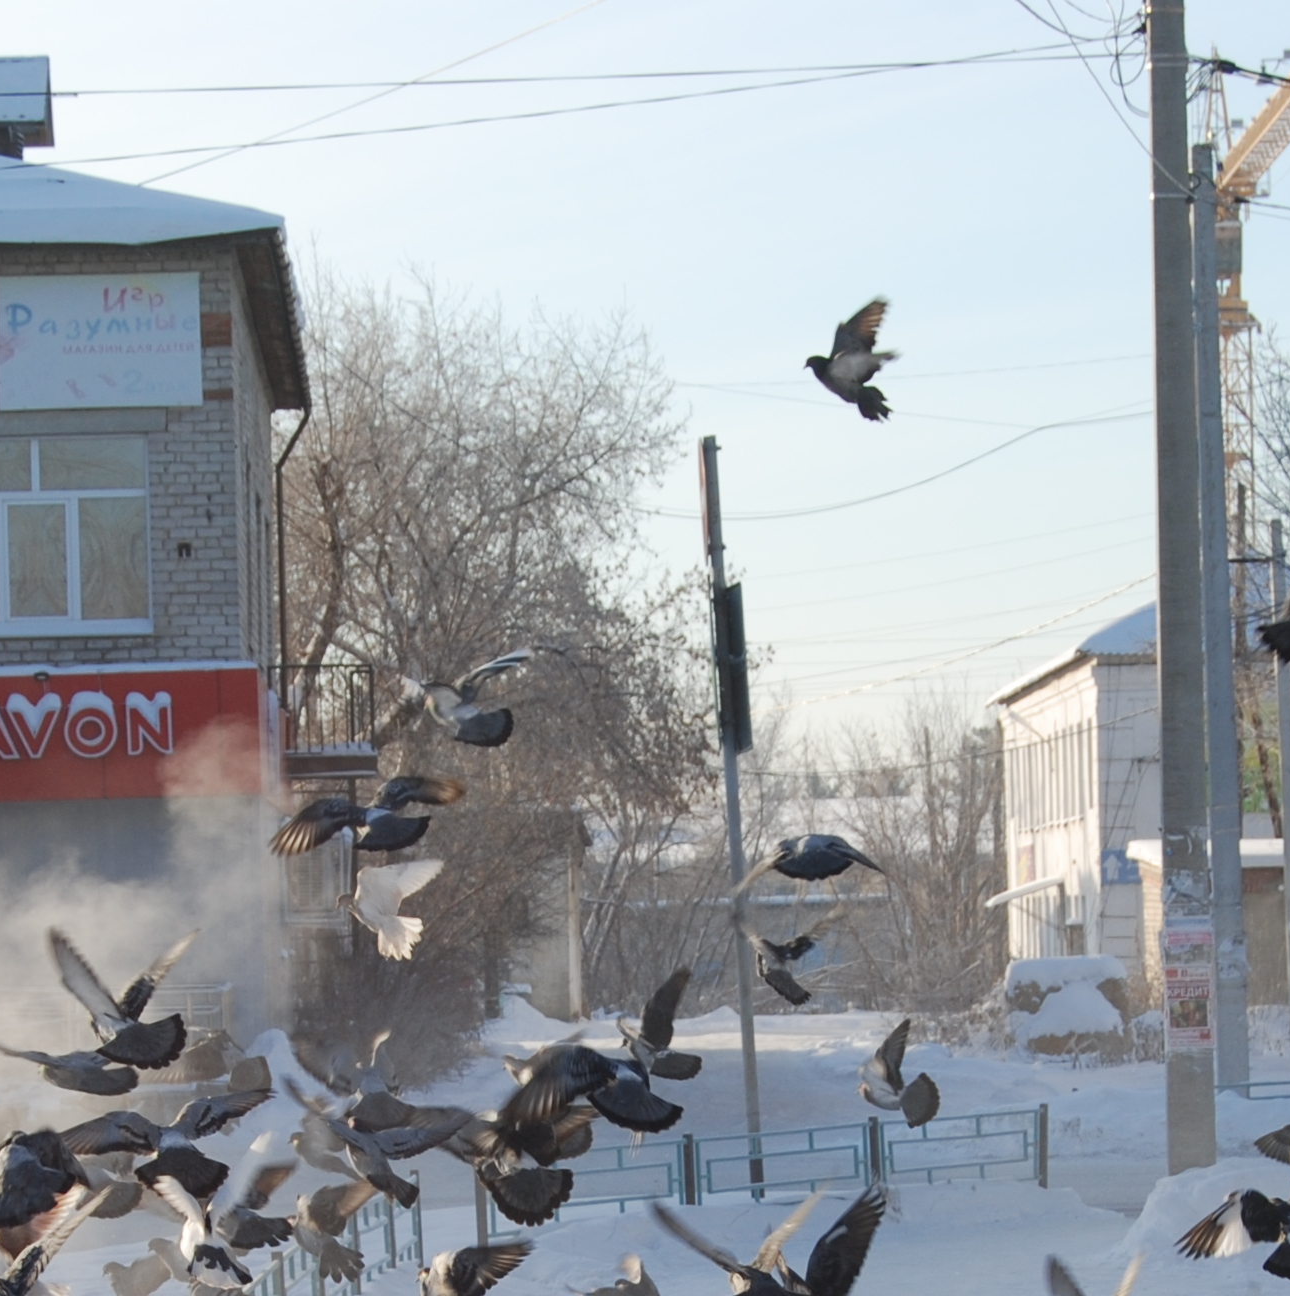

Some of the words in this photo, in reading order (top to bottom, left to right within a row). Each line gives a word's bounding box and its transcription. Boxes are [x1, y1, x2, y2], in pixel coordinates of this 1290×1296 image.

[6, 303, 197, 341] Разумные
[63, 345, 121, 354] МАГАЗИН
[125, 344, 152, 354] ДЛЯ
[156, 343, 195, 353] ДЕТЕЙ
[1168, 986, 1209, 997] КРЕДИТ
